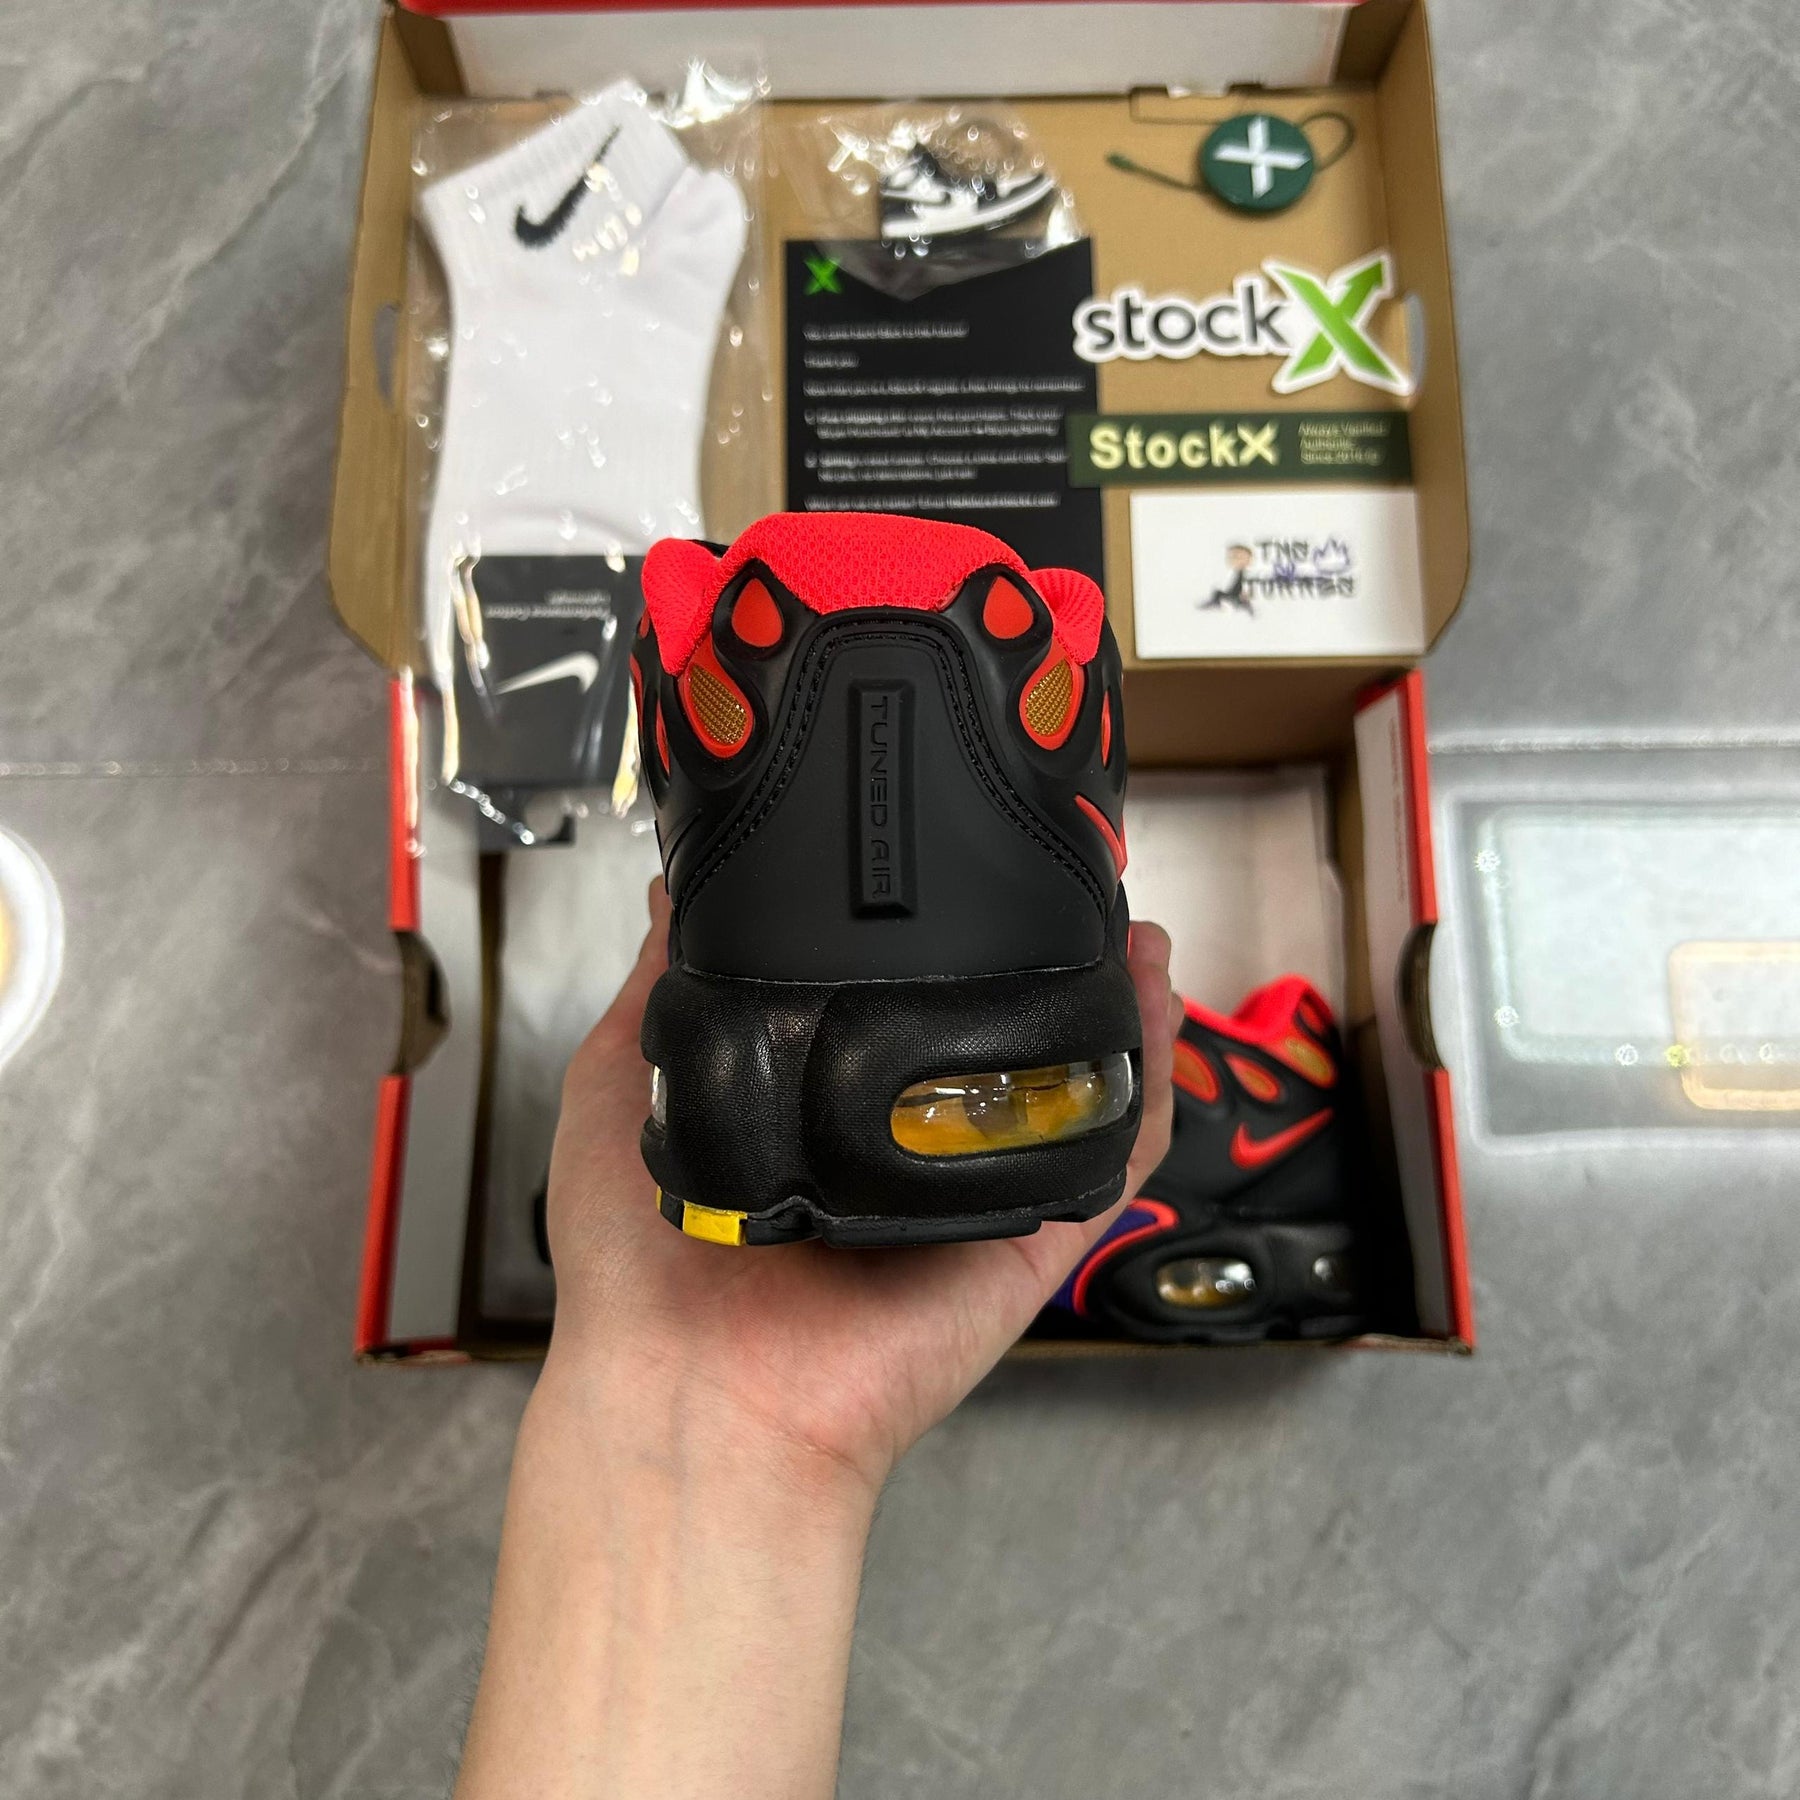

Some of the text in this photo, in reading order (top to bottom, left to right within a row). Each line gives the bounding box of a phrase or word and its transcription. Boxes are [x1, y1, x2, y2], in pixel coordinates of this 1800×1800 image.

[1089, 420, 1281, 470] StockX
[869, 695, 891, 900] TUNED AIR
